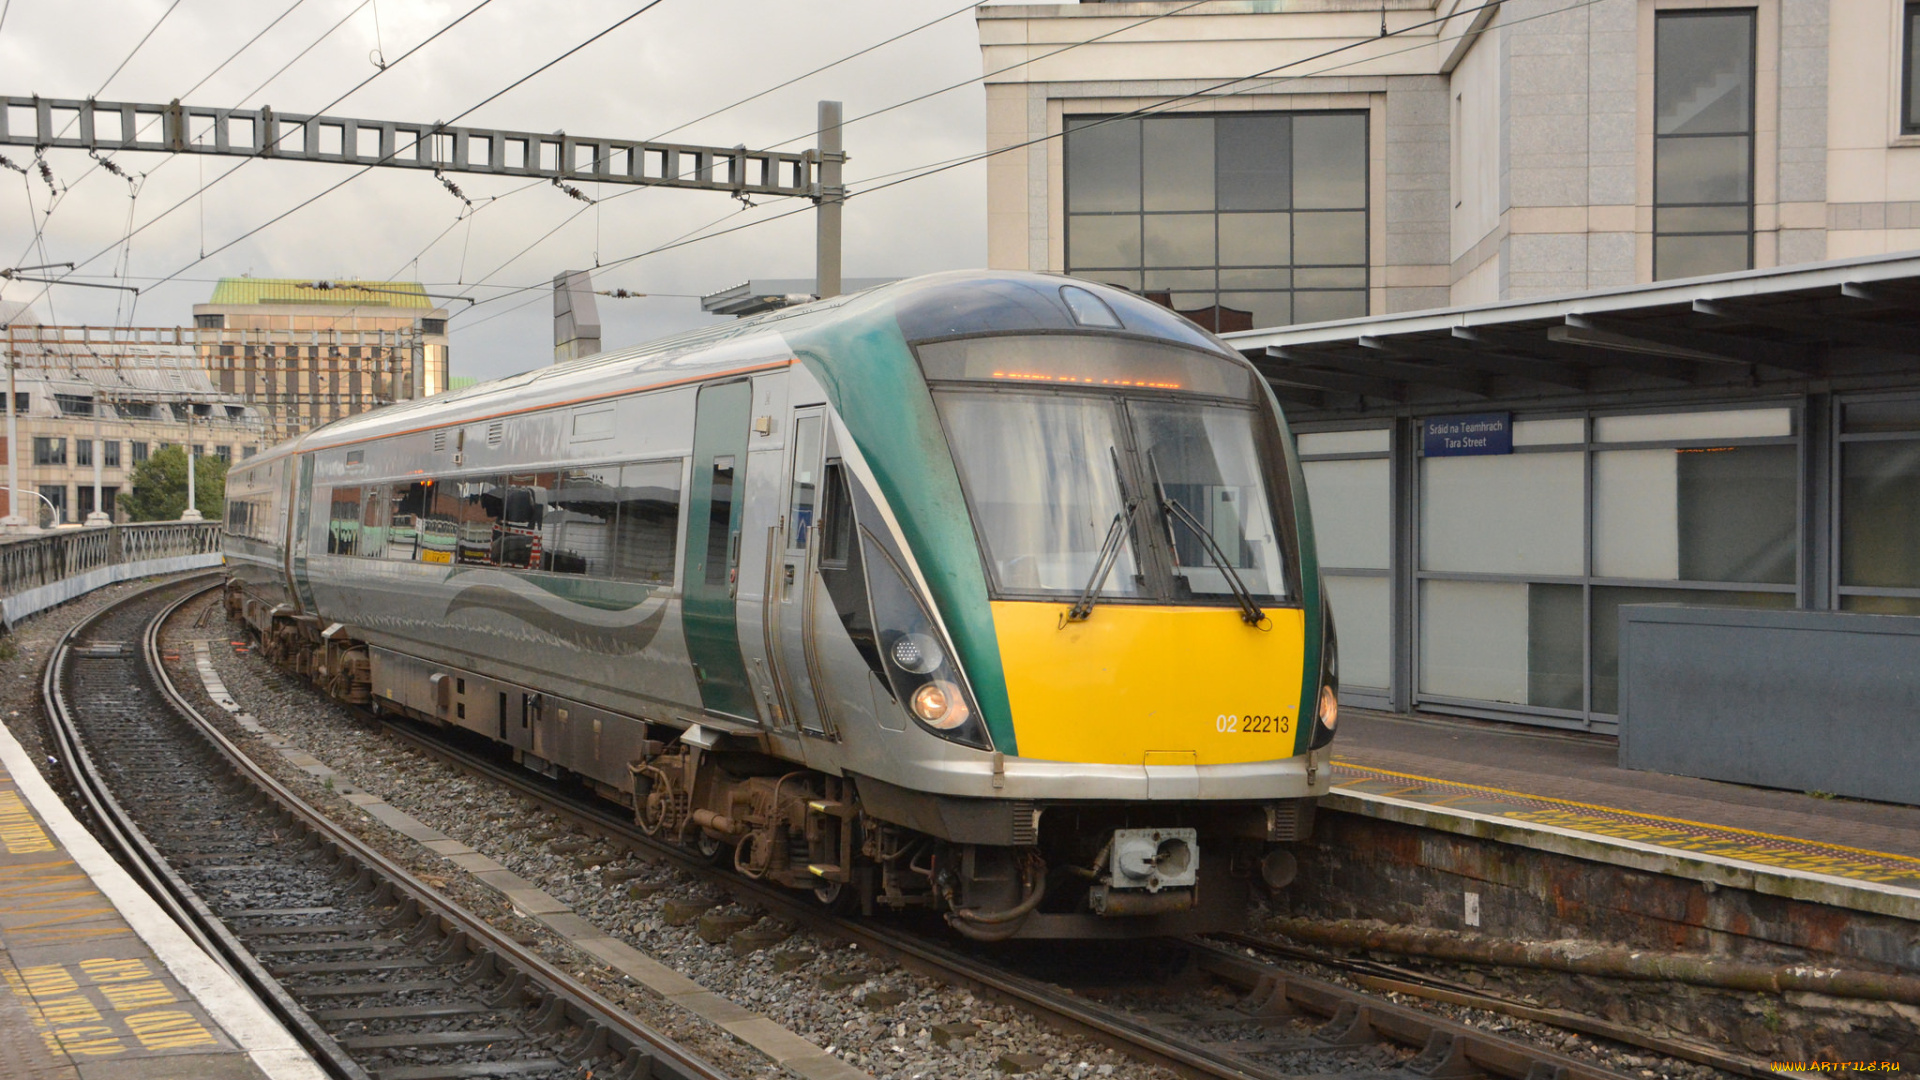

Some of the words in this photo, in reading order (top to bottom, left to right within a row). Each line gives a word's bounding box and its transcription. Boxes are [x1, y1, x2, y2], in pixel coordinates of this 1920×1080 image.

[1429, 423, 1449, 435] Sráid
[1450, 425, 1459, 434] na
[1460, 420, 1503, 433] Teamhrach
[1444, 437, 1461, 449] Tara
[1462, 436, 1487, 448] Street
[1216, 714, 1238, 733] 02
[1242, 715, 1289, 733] 22213
